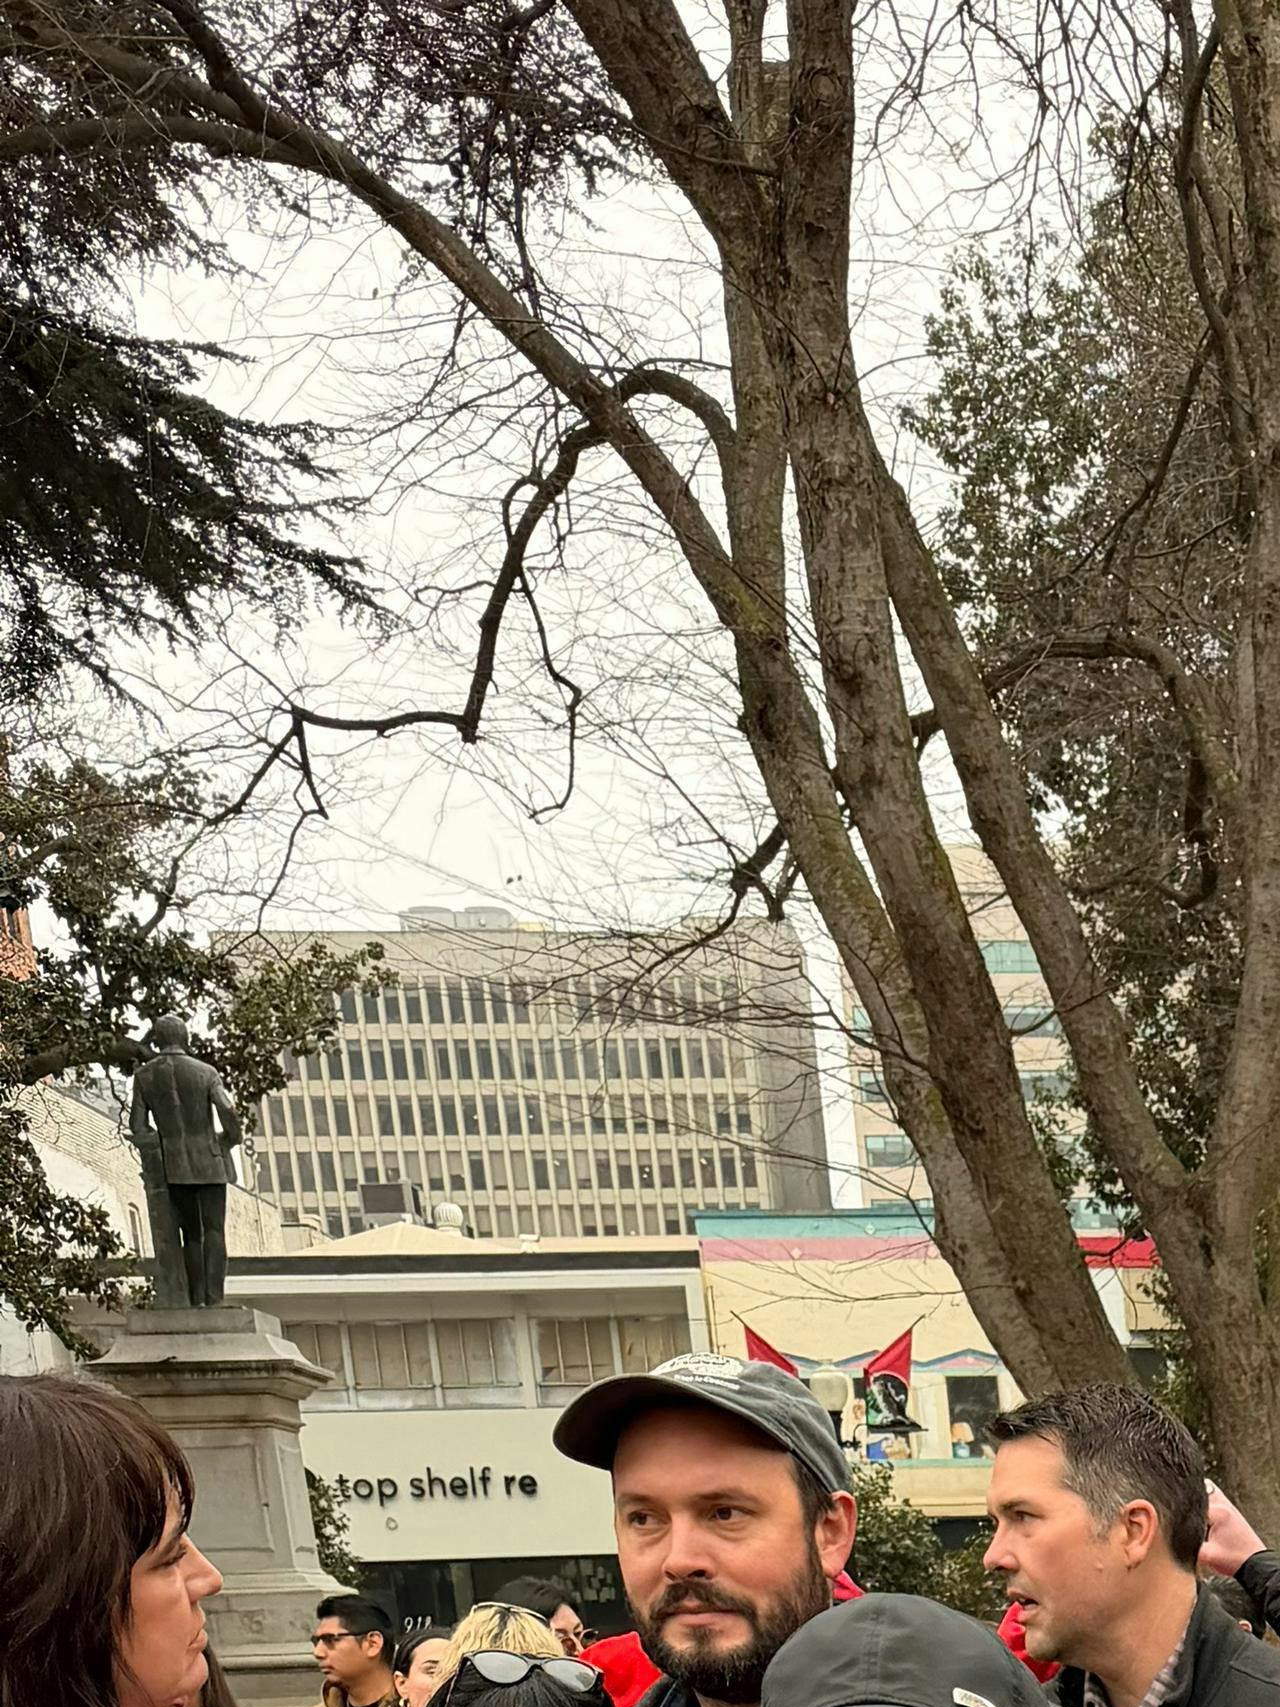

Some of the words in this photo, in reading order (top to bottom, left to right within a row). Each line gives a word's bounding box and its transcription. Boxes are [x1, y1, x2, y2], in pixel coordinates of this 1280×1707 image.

[335, 1473, 398, 1507] top
[410, 1466, 491, 1498] shelf
[504, 1474, 538, 1497] re
